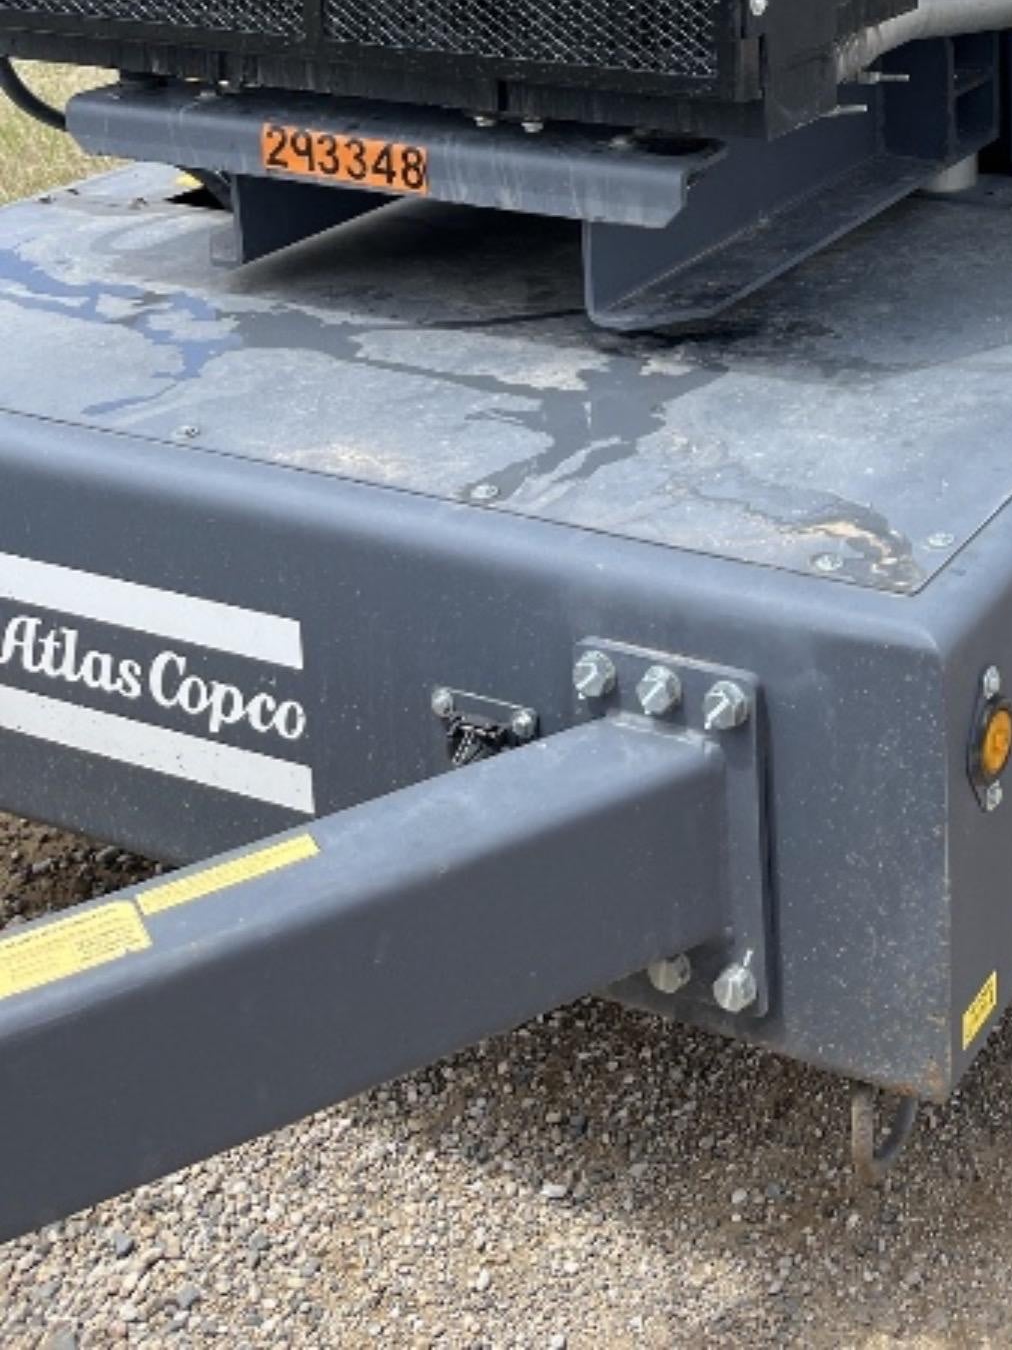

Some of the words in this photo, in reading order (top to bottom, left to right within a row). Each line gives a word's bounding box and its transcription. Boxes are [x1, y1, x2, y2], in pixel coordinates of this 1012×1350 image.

[265, 124, 425, 190] 293348
[0, 614, 142, 699] Atlas
[149, 650, 306, 740] Copco
